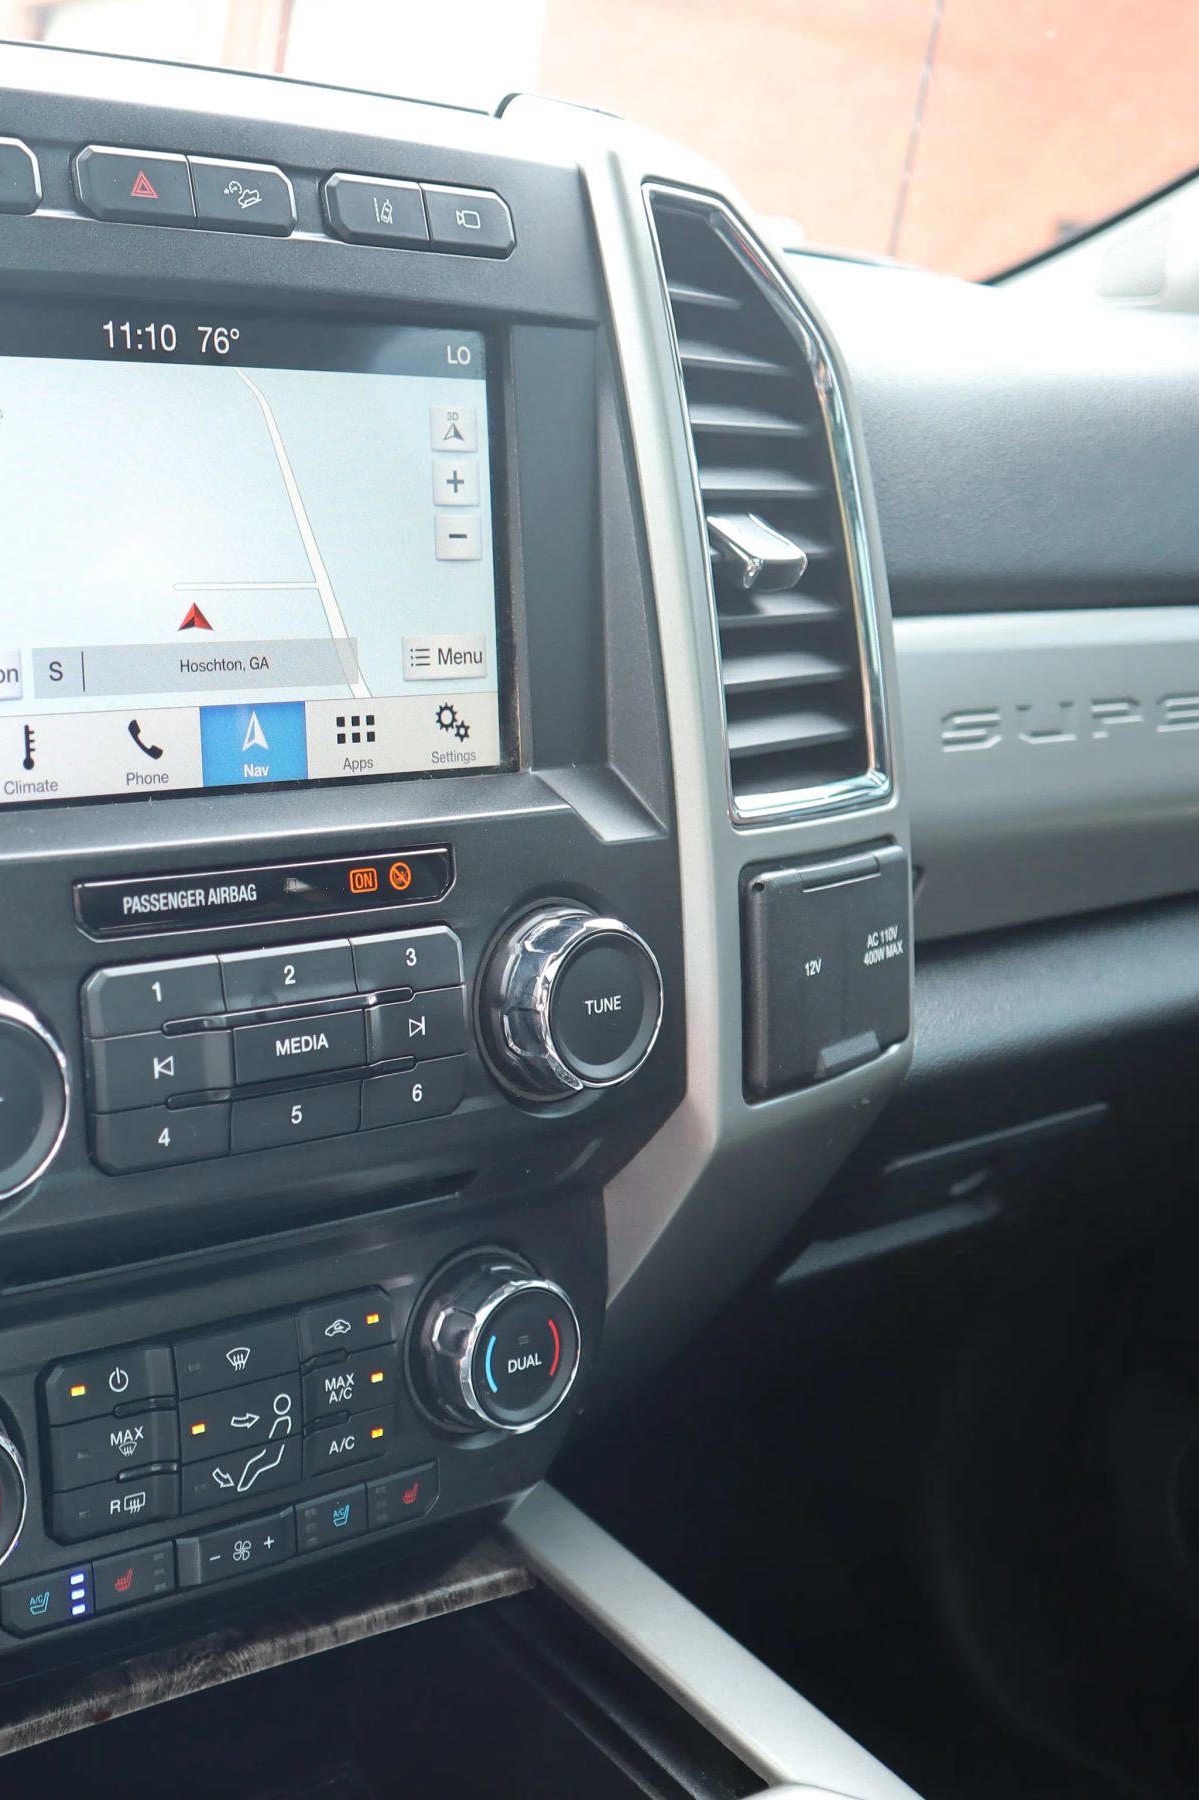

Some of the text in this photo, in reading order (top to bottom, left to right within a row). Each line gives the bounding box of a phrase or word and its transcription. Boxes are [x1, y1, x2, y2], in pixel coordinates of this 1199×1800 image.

[102, 320, 240, 354] 11:10 76°
[447, 345, 472, 365] LO
[446, 412, 459, 421] 3D
[179, 656, 270, 673] Hoschton, GA
[437, 647, 483, 666] Menu
[48, 661, 64, 682] S
[940, 691, 1199, 752] SUPE
[343, 757, 374, 772] Apps
[431, 750, 477, 766] Settings
[126, 771, 169, 787] Phone
[243, 763, 270, 778] Nav
[3, 778, 59, 796] Climate
[355, 872, 374, 889] ON
[122, 884, 257, 915] PASSENGER AIRBAG
[867, 924, 898, 949] AC 110V
[404, 947, 418, 967] 3
[864, 939, 903, 966] 400W MAX
[283, 964, 296, 985] 2
[805, 958, 822, 977] 12V
[151, 981, 162, 1002] 1
[584, 995, 622, 1015] TUNE
[275, 1033, 329, 1057] MEDIA
[411, 1083, 423, 1103] 6
[290, 1105, 303, 1125] 5
[157, 1128, 171, 1147] 4
[507, 1353, 542, 1373] DUAL
[324, 1373, 355, 1392] MAX
[328, 1386, 353, 1404] A/C
[110, 1426, 144, 1447] MAX
[328, 1435, 356, 1454] A/C
[110, 1500, 121, 1514] R
